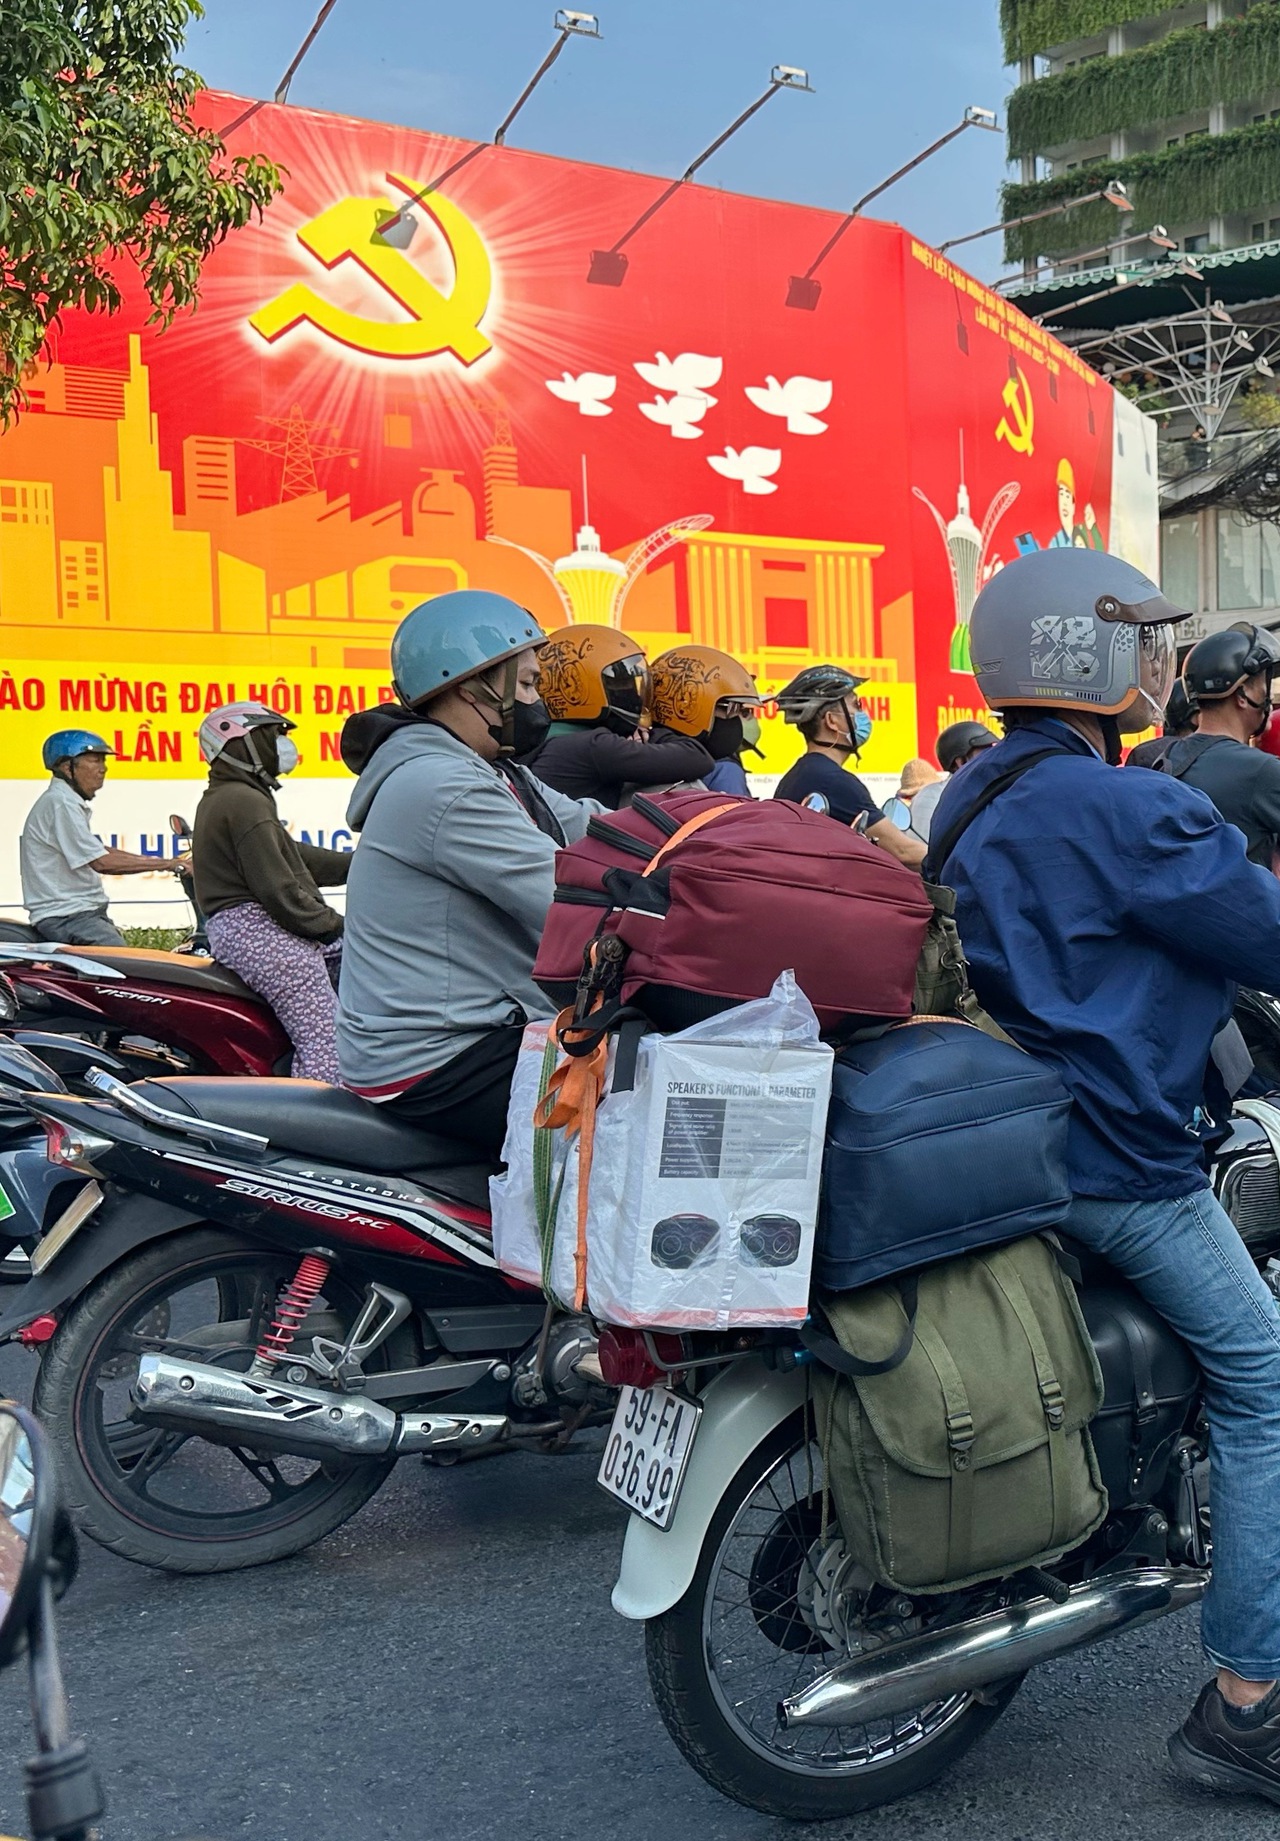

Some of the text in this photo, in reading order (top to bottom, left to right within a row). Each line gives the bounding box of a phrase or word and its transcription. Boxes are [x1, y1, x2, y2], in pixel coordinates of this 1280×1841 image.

[60, 672, 168, 713] MỪNG
[114, 720, 182, 762] LẦN
[667, 1082, 714, 1095] SPEAKER'S
[768, 1086, 816, 1098] PARAMETER
[216, 1178, 392, 1230] SIRIUS RC
[625, 1387, 684, 1458] 59-FA
[604, 1433, 674, 1518] 036.99
